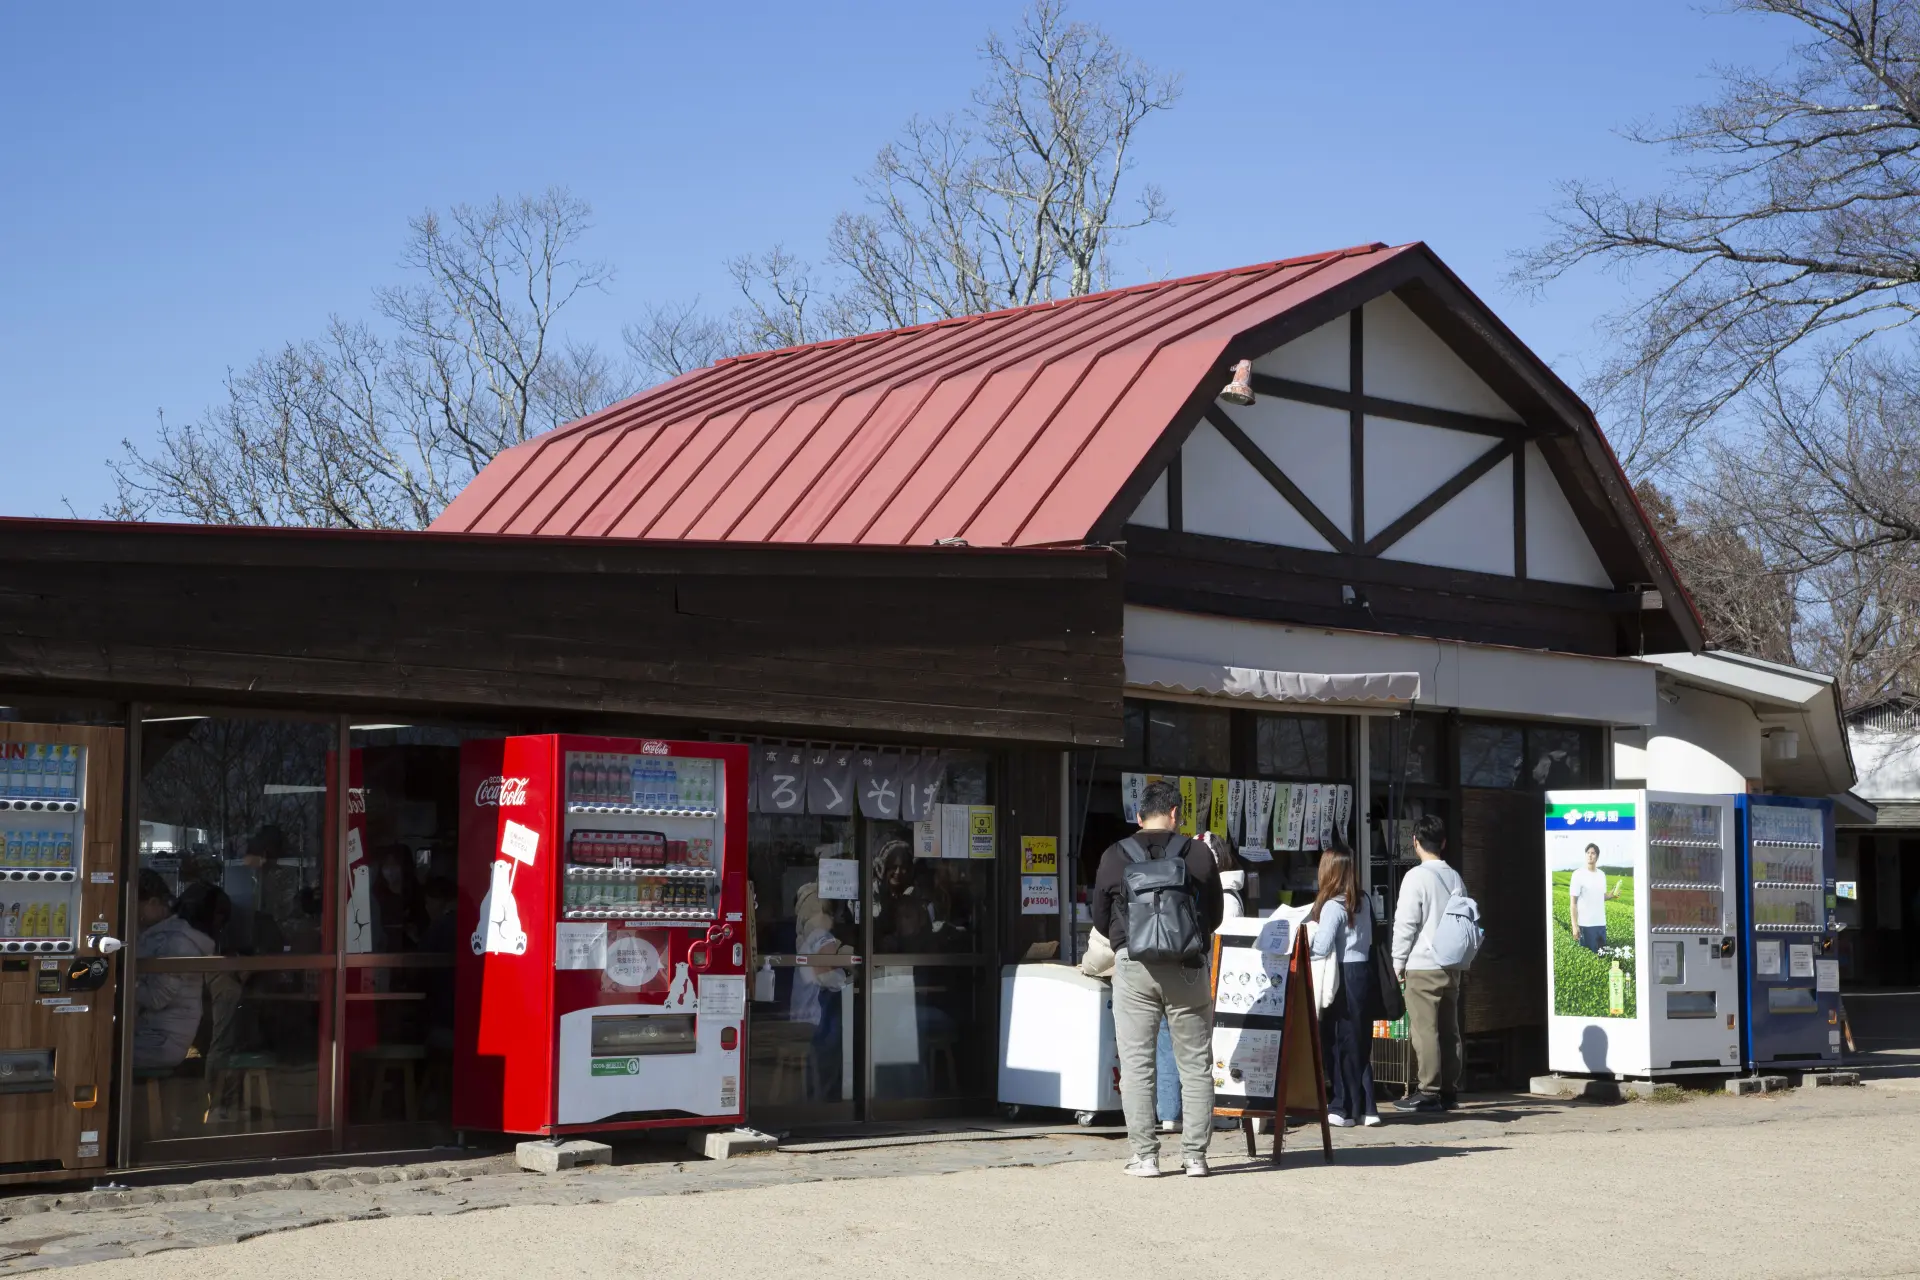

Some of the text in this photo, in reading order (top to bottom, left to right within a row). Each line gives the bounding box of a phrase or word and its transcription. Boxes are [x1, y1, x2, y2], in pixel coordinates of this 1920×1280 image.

[642, 742, 669, 755] Coca-Cola
[766, 751, 873, 767] 高尾山名物
[475, 778, 530, 807] Coca-Cola
[747, 774, 940, 816] ろゝそば
[1032, 853, 1055, 865] 250円
